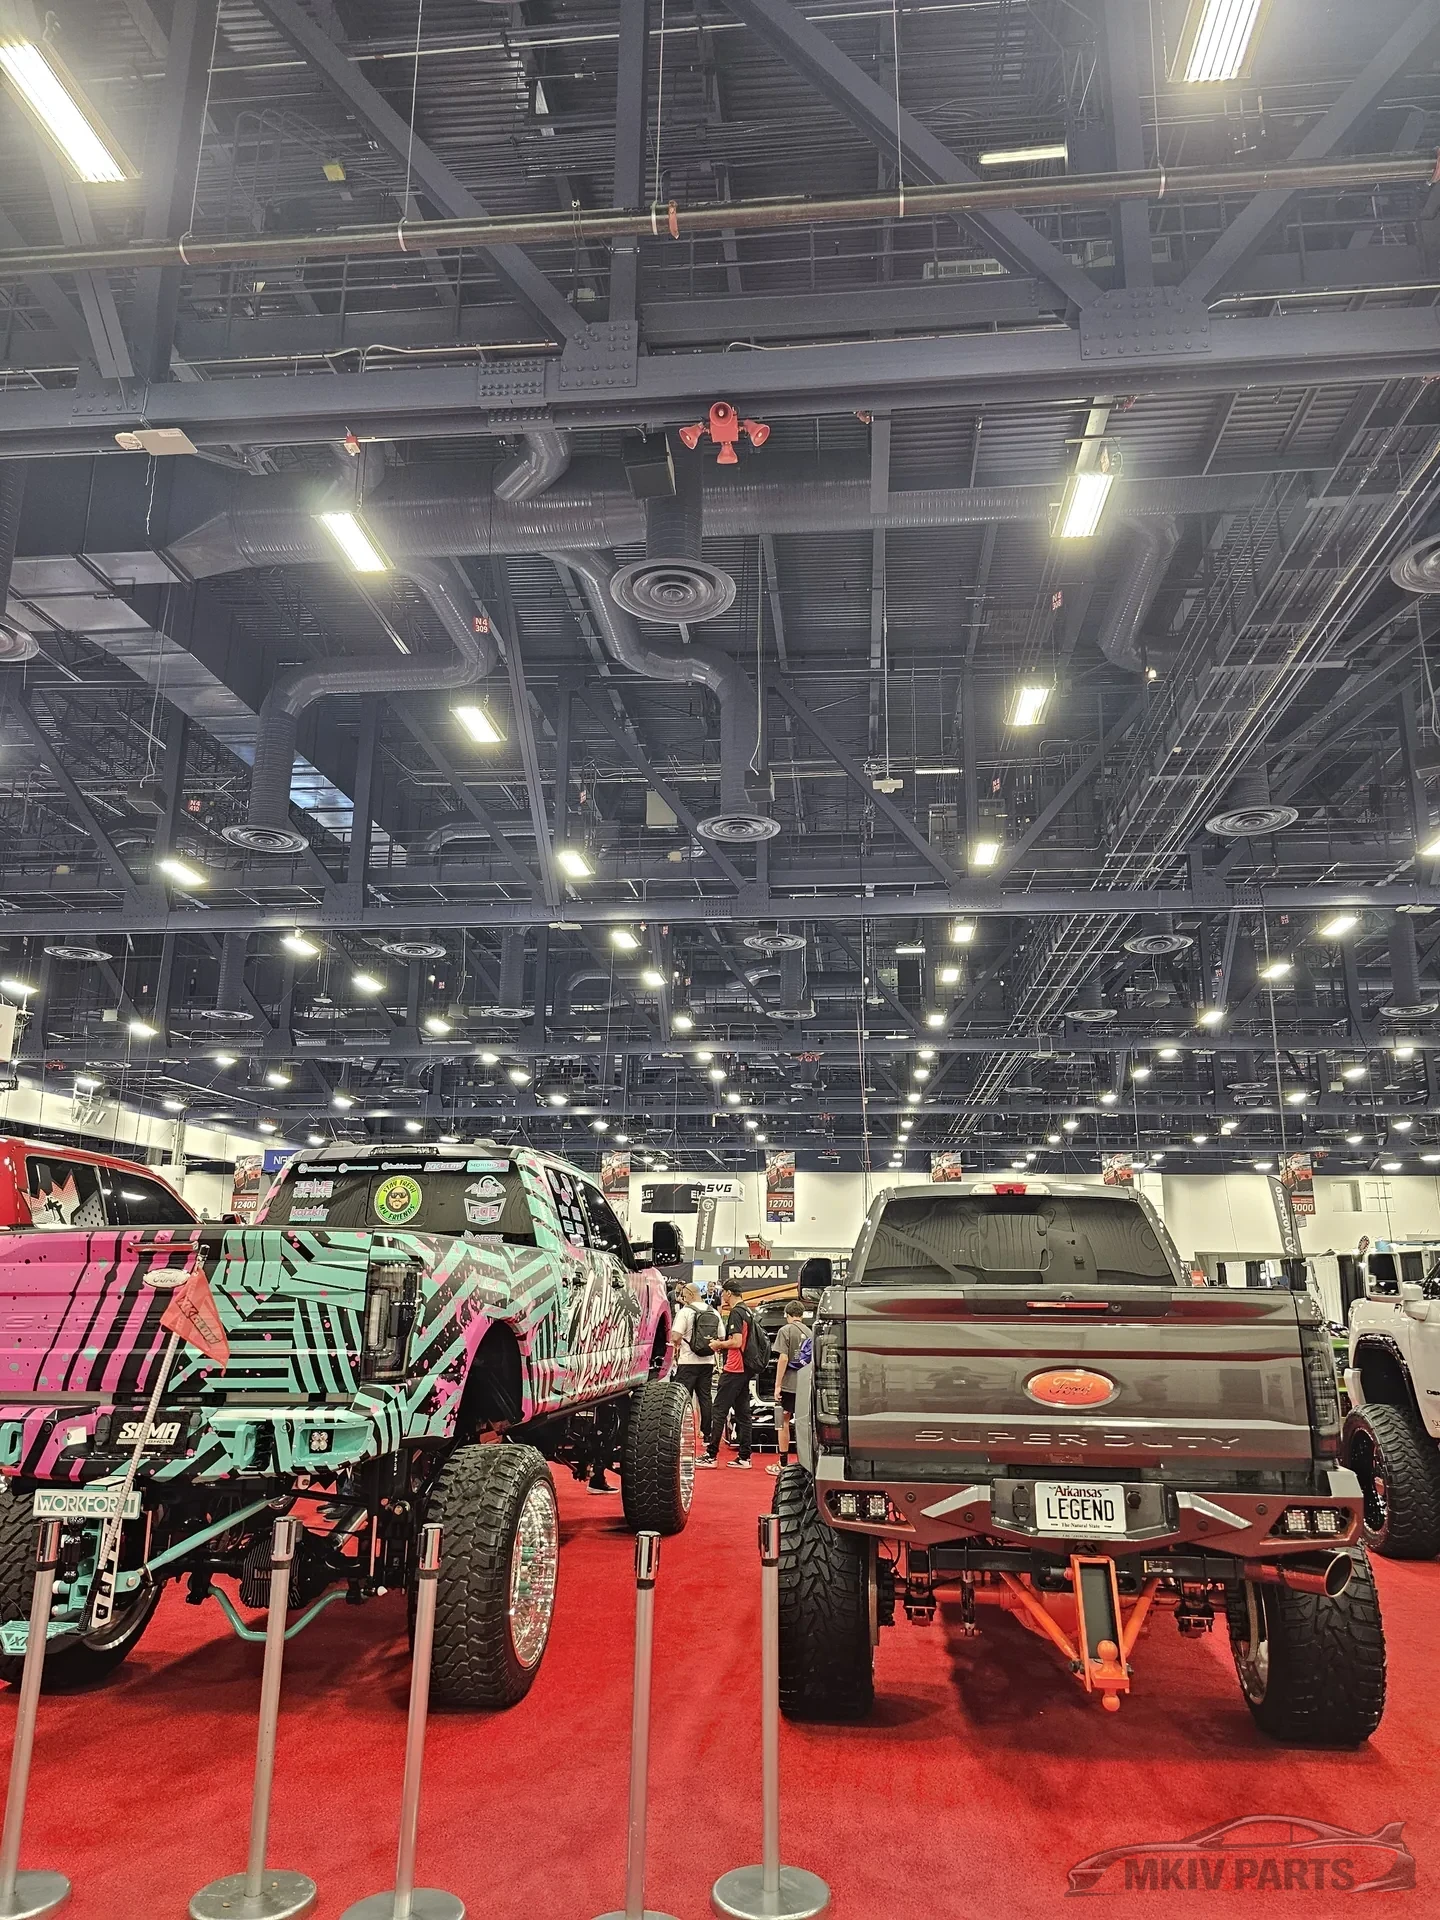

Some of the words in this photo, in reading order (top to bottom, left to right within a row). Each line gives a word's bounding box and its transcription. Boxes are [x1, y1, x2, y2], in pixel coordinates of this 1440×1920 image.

[475, 625, 488, 633] 309
[383, 1180, 398, 1193] STAY
[400, 1179, 416, 1193] FRESH
[233, 1200, 257, 1209] 12400
[768, 1200, 793, 1208] 12700
[388, 1204, 415, 1220] FRIENDS
[152, 1271, 179, 1284] Ford
[1049, 1376, 1093, 1396] Ford
[915, 1430, 1088, 1446] SUPER
[1103, 1434, 1240, 1449] DUTY
[1055, 1485, 1103, 1498] Arkansas
[1046, 1498, 1115, 1521] LEGEND
